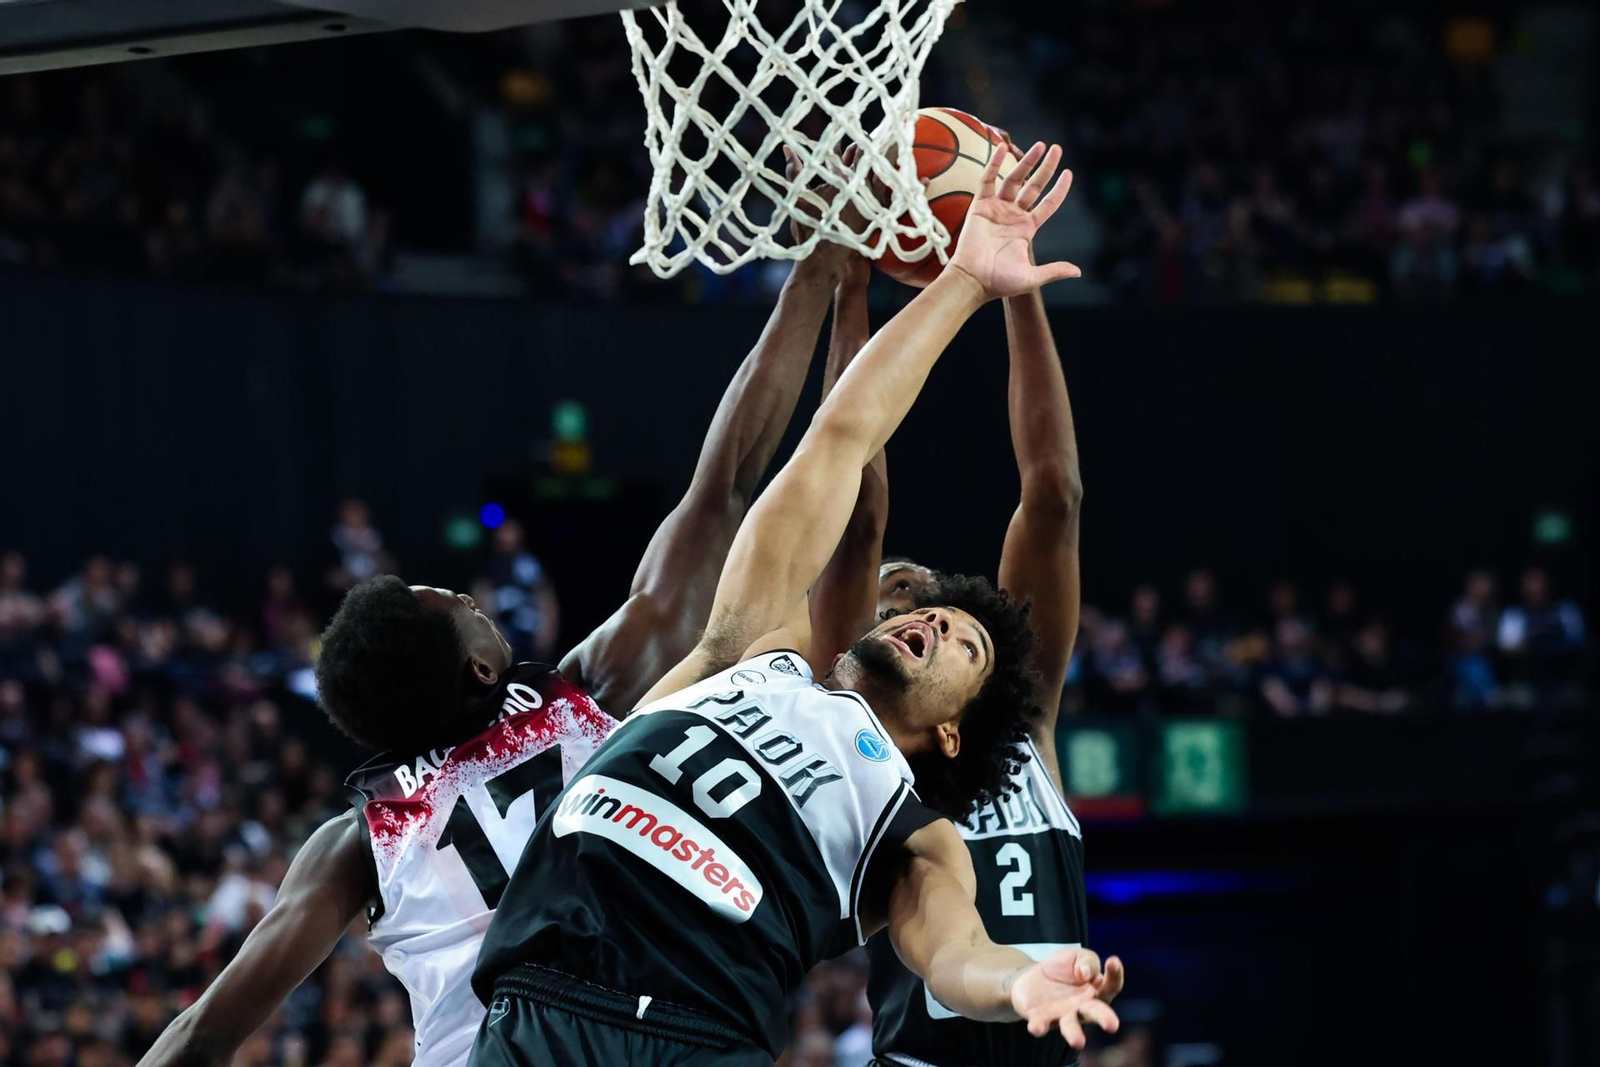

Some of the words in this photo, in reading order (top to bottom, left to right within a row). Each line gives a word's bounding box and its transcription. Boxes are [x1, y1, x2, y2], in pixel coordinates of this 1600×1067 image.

[649, 724, 762, 819] 10
[686, 689, 844, 809] PAOK
[559, 788, 756, 913] winmasters
[996, 842, 1034, 916] 2
